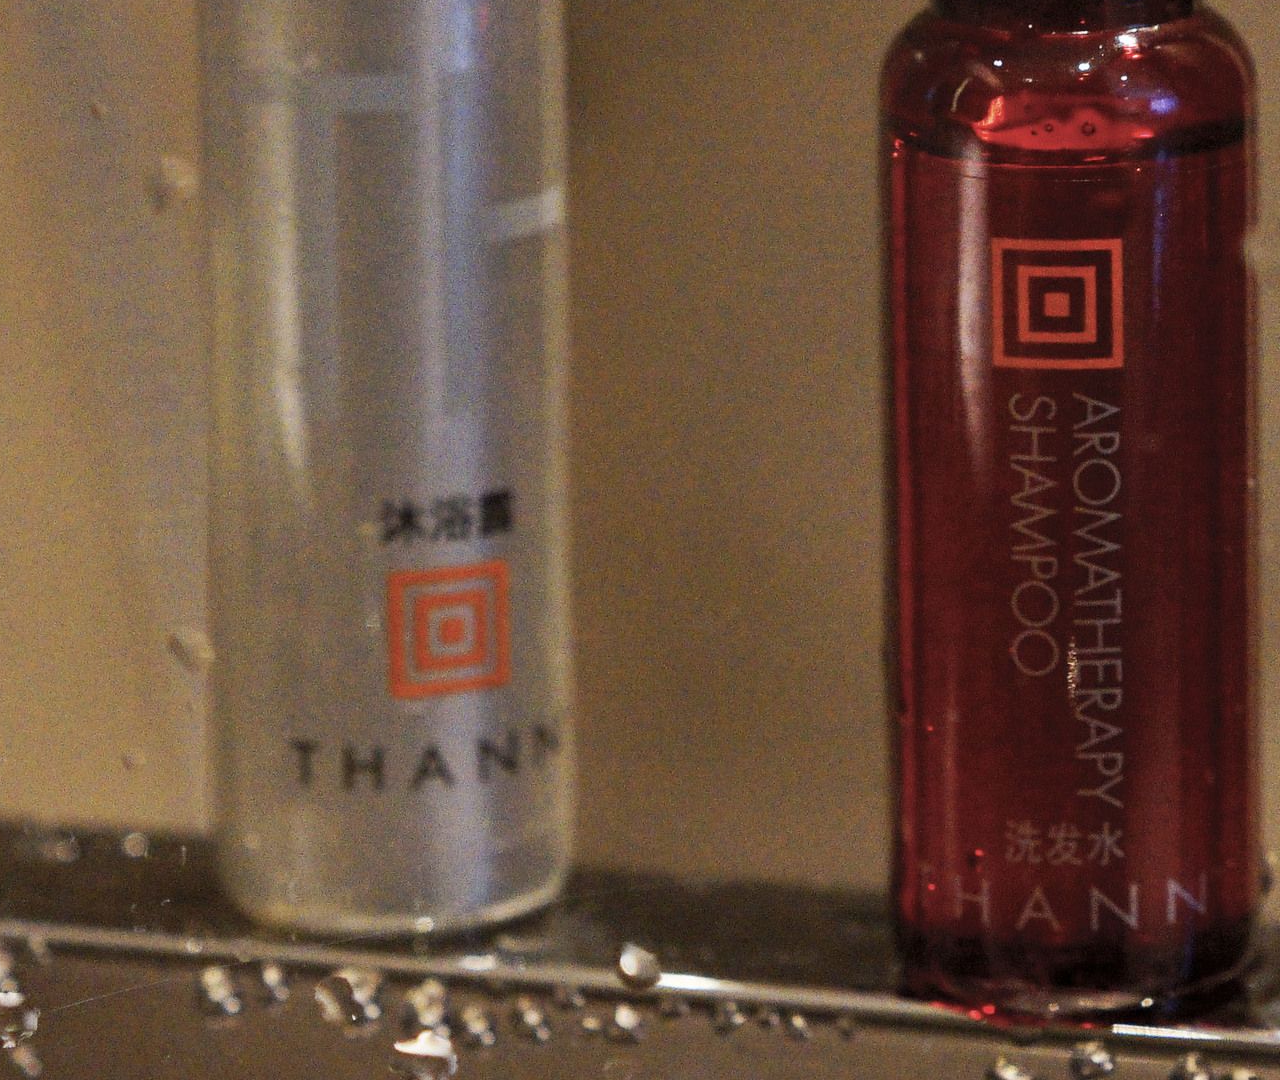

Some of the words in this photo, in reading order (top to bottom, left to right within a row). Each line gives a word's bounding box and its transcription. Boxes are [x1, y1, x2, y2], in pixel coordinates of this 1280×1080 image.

[1008, 393, 1060, 677] SHAMPOO
[1072, 392, 1124, 809] AROMATHERAPY
[1005, 821, 1125, 865] 洗发水
